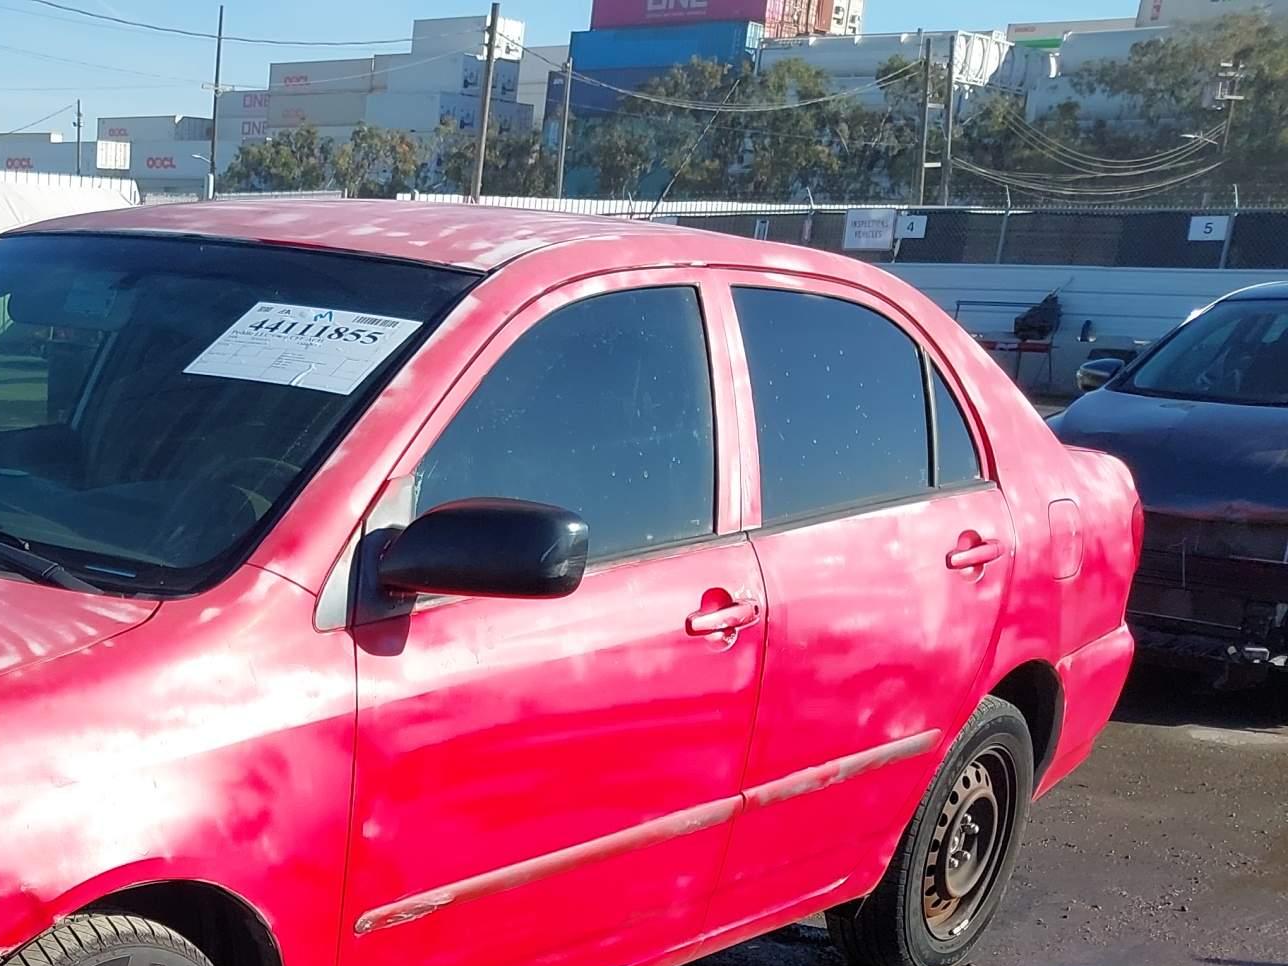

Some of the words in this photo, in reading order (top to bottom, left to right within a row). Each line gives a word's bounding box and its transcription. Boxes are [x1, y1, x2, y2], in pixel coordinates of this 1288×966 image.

[906, 222, 915, 232] 4
[1203, 222, 1214, 234] 5
[249, 318, 384, 345] 44111855
